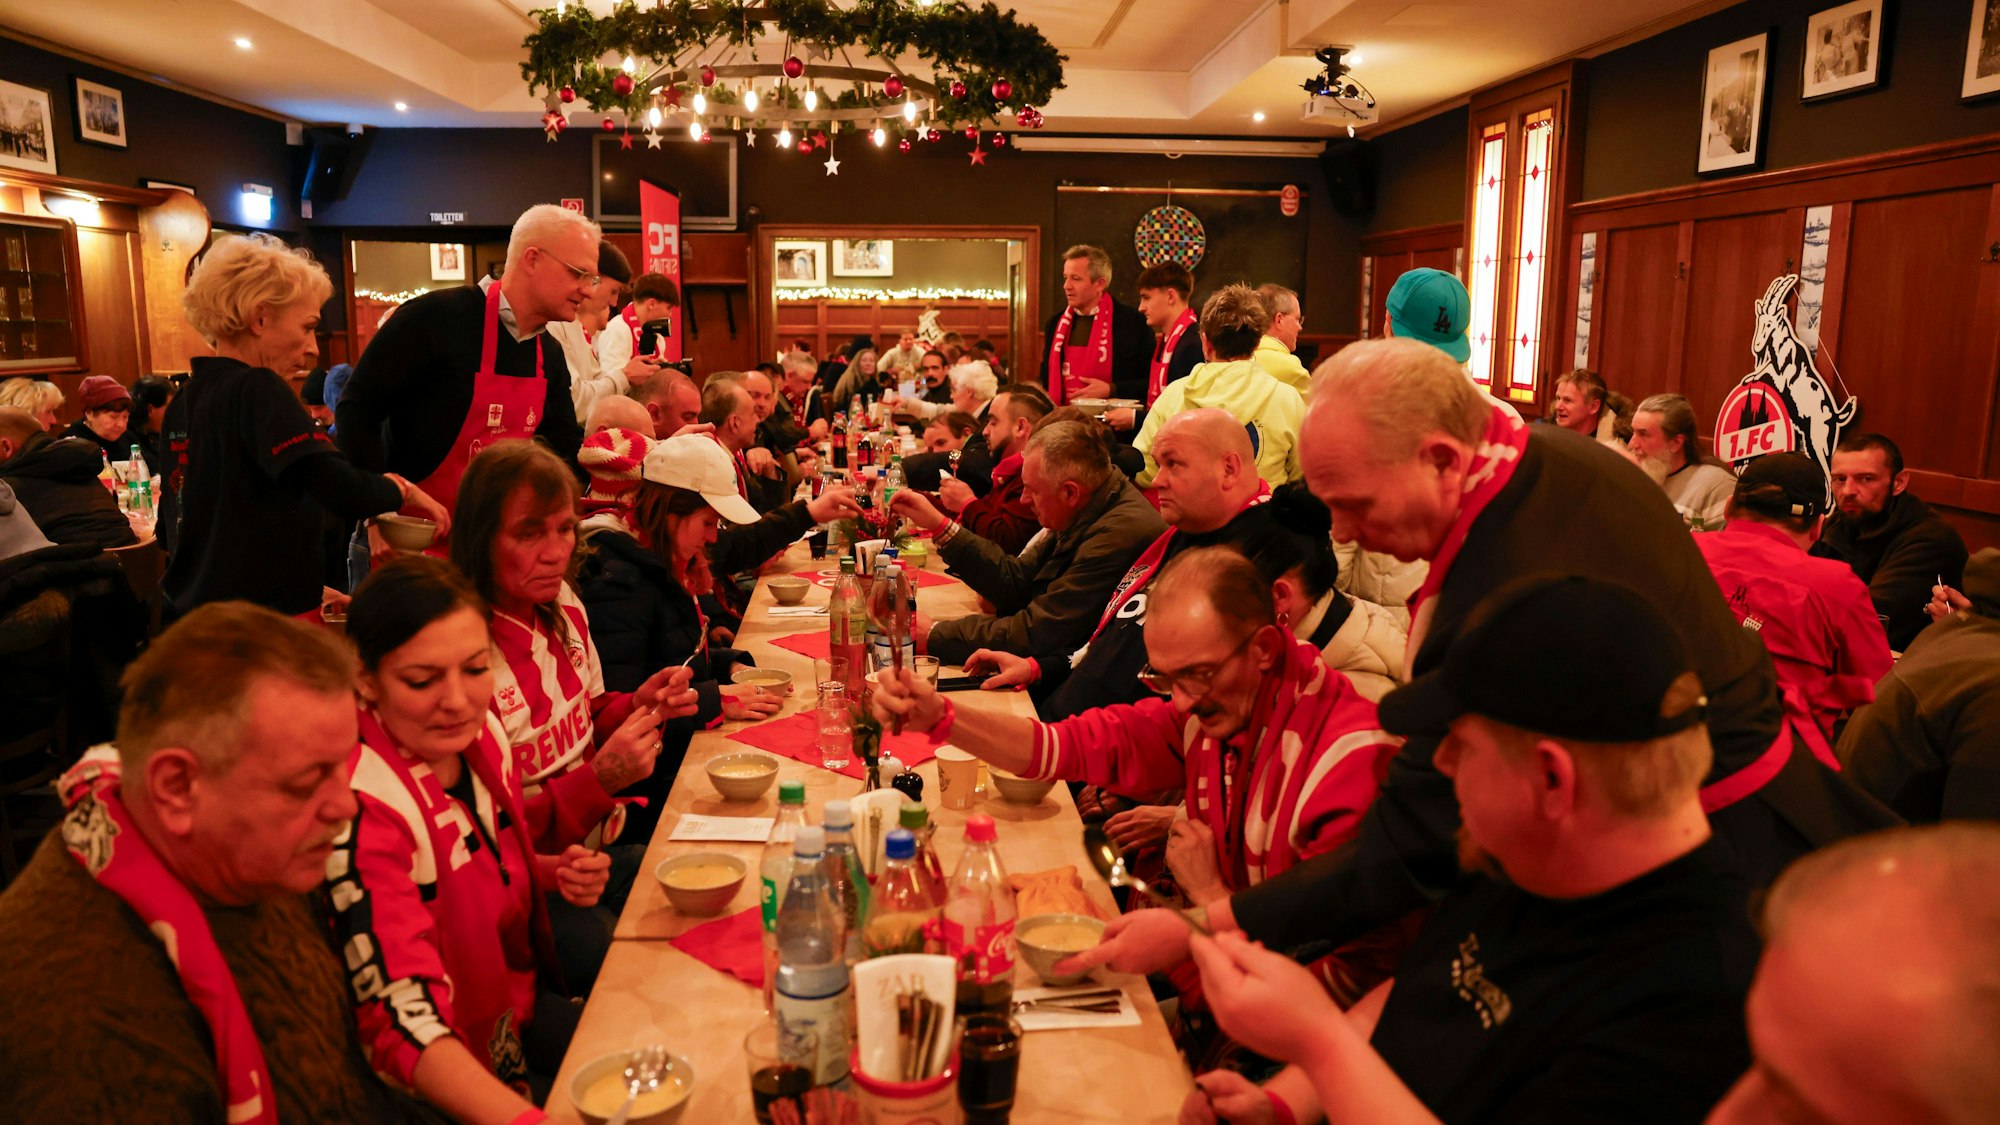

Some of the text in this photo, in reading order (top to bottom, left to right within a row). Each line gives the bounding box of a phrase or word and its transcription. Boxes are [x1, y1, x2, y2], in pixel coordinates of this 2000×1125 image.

[430, 212, 464, 222] TOILETTEN
[1433, 305, 1451, 334] LA
[511, 703, 587, 777] REWE
